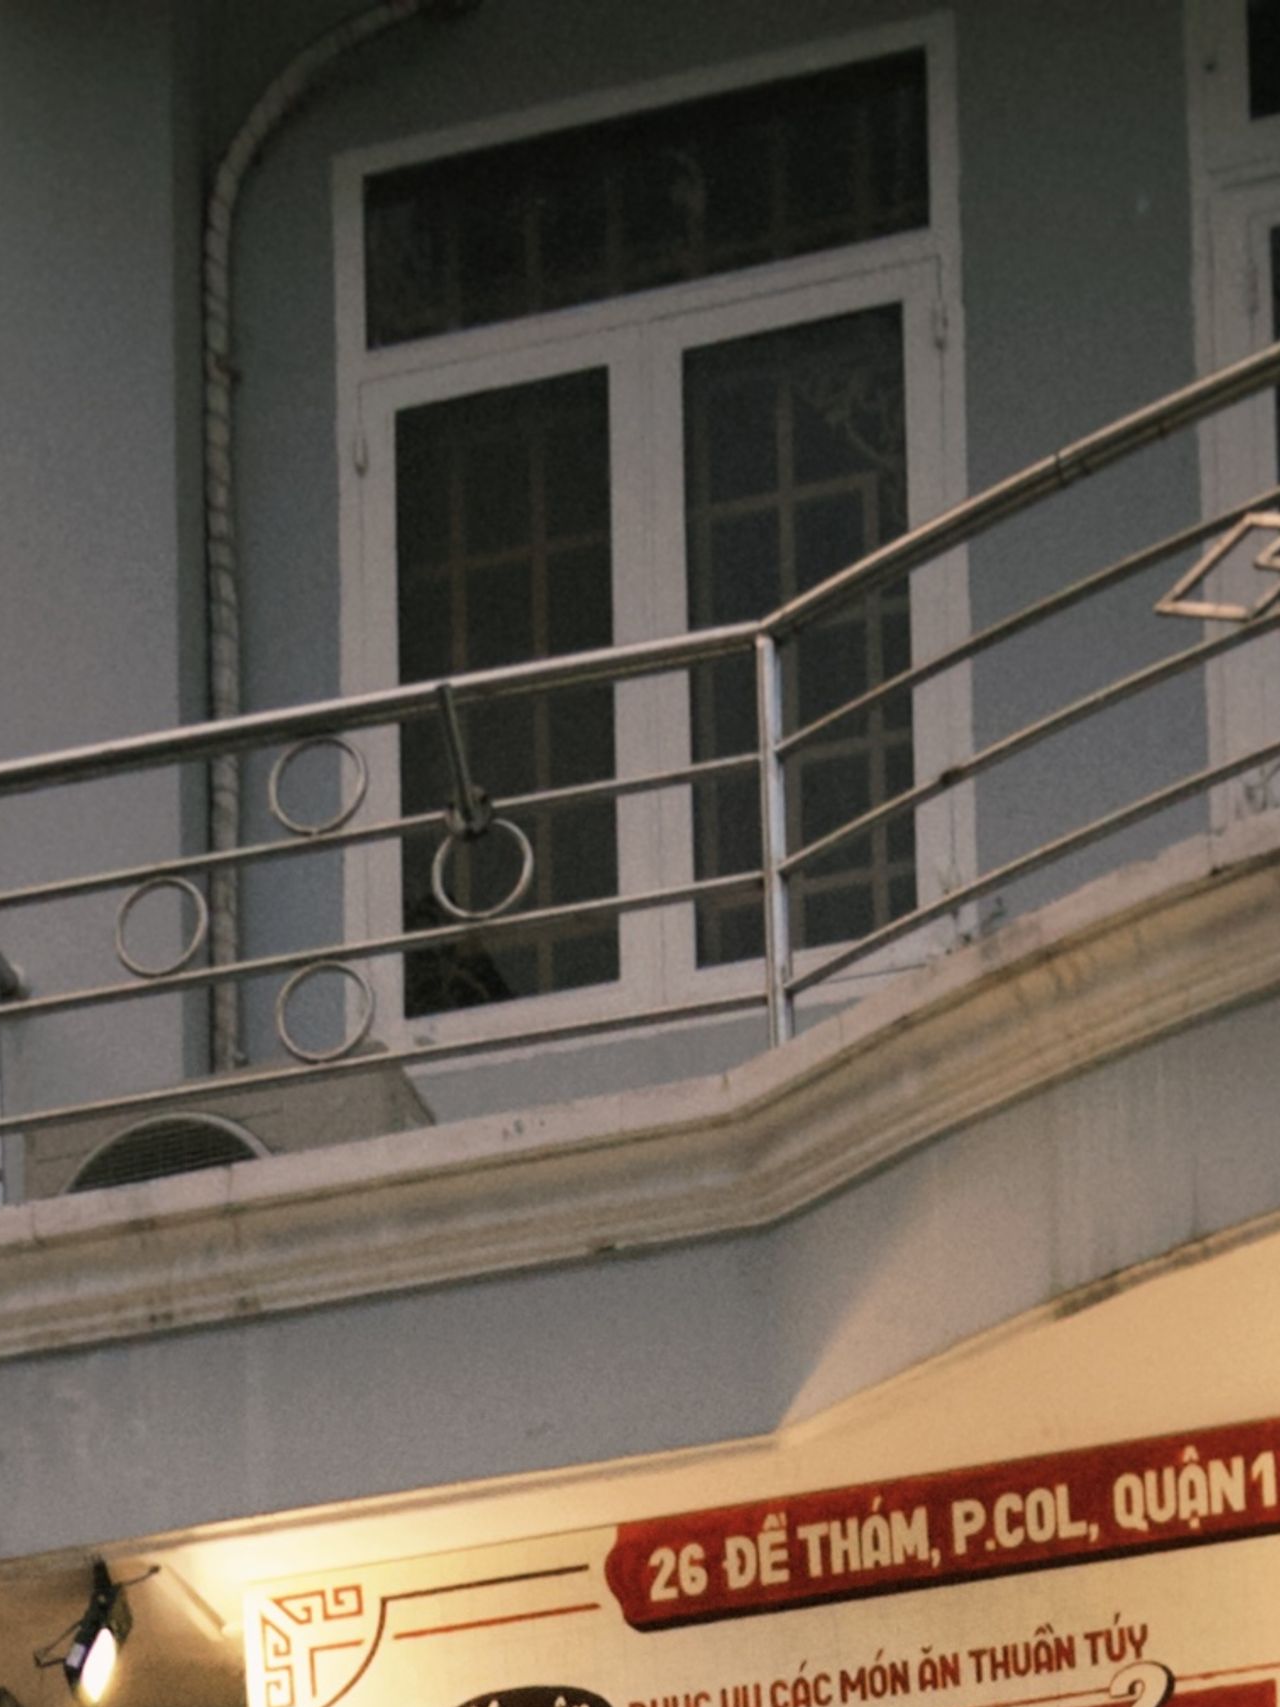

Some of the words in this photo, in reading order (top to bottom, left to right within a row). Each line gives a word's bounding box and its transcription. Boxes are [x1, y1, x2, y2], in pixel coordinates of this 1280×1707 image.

[647, 1542, 708, 1602] 26
[797, 1497, 941, 1574] THÁM,
[951, 1484, 1100, 1556] P.COL,
[839, 1648, 910, 1704] MÓN
[919, 1645, 962, 1691] ĂN
[1084, 1613, 1150, 1663] TÚY
